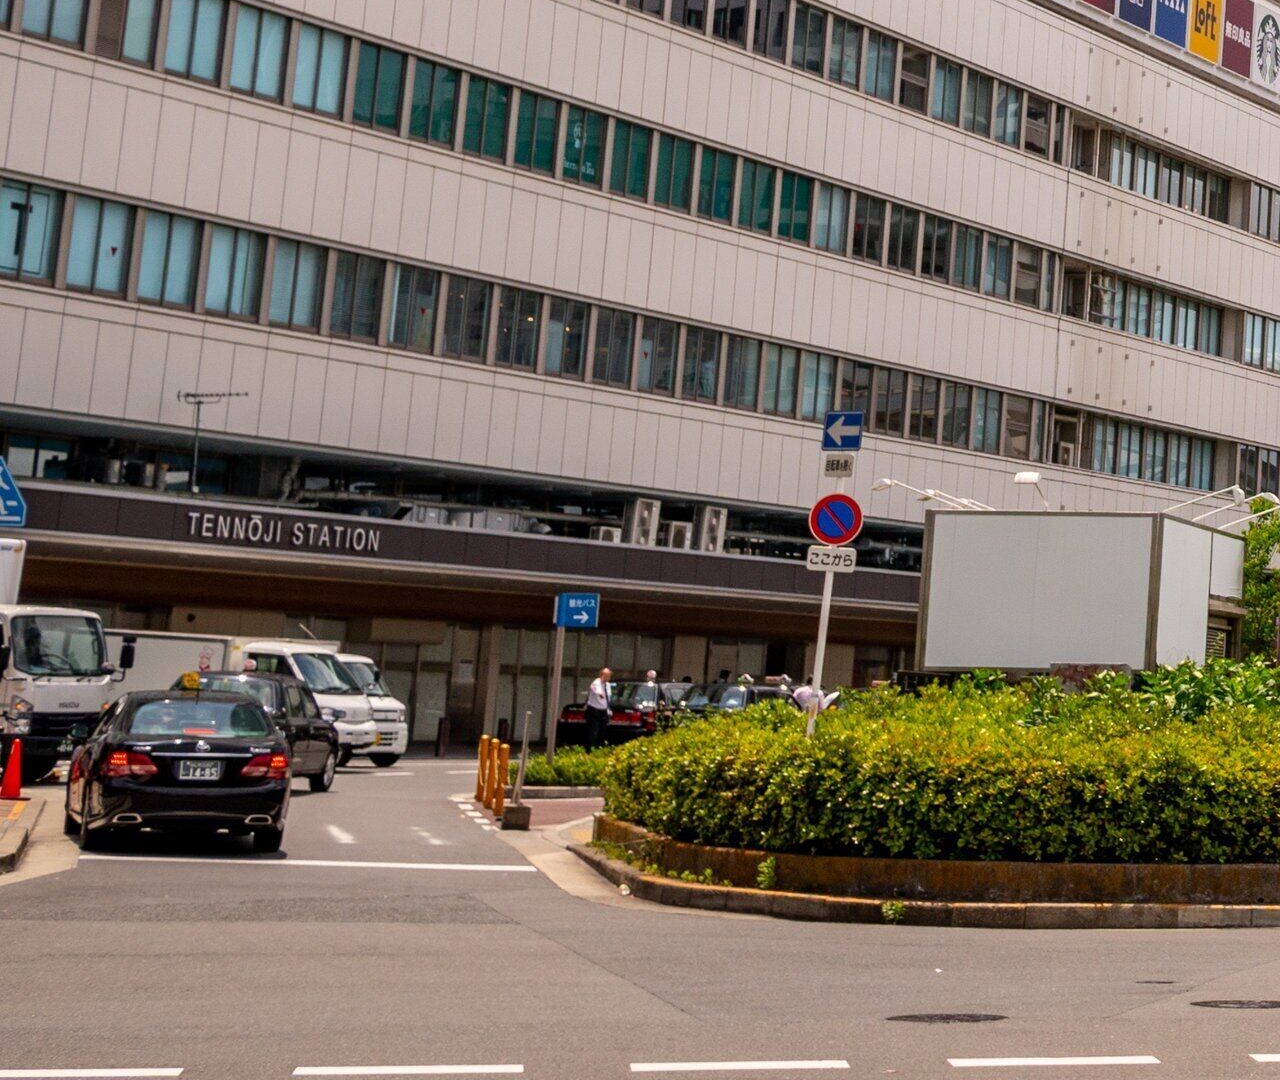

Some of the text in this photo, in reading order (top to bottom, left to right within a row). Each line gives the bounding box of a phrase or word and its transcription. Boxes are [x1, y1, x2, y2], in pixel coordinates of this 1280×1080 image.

[1225, 20, 1251, 49] 無印良品
[188, 511, 380, 552] TENNŌJI STATION
[809, 552, 853, 567] ここから
[569, 598, 595, 608] 観光バス
[189, 767, 217, 778] 14-85
